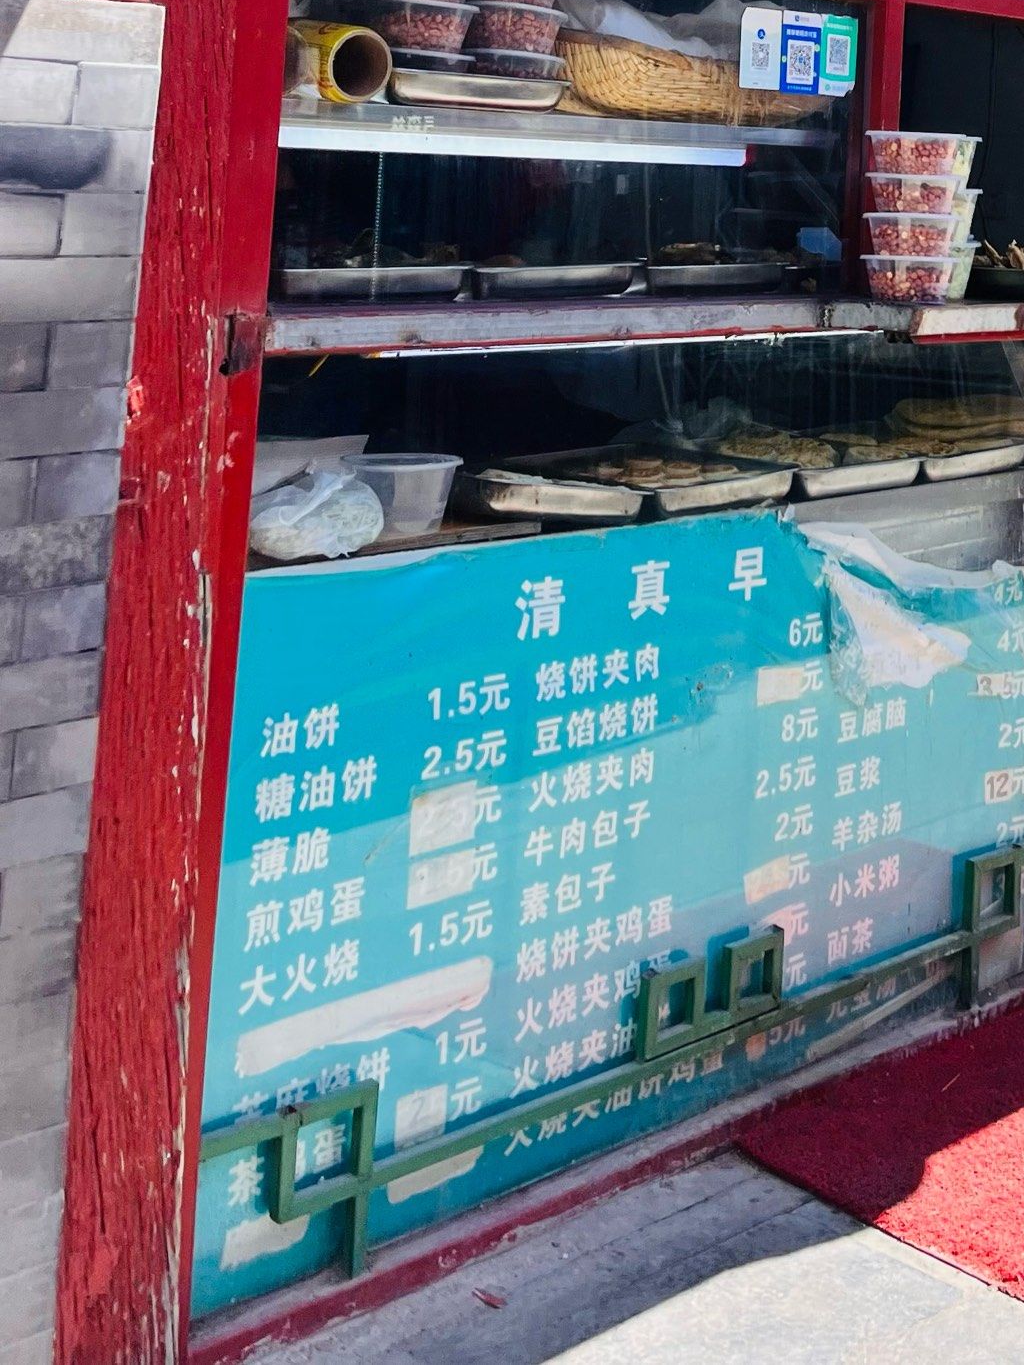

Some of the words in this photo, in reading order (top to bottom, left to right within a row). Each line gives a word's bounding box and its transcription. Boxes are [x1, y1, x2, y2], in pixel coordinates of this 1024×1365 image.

[534, 643, 660, 703] 烧饼夹肉
[788, 612, 824, 647] 6元
[260, 703, 340, 758] 油饼
[427, 673, 511, 720] 1.5元
[532, 694, 659, 757] 豆馅烧饼
[837, 697, 907, 743] 豆腐脑
[254, 755, 378, 823] 糖油饼
[420, 729, 507, 781] 2.5元
[528, 746, 655, 812] 火烧夹肉
[781, 707, 819, 743] 8元
[834, 756, 881, 798] 豆浆
[523, 799, 651, 866] 牛肉包子
[755, 755, 816, 799] 2.5元
[831, 801, 902, 852] 羊杂汤
[250, 827, 331, 886] 薄脆
[518, 861, 616, 926] 素包子
[774, 804, 814, 843] 2元
[829, 854, 900, 908] 小米粥
[244, 876, 366, 953] 煎鸡蛋
[516, 895, 673, 983] 烧饼夹鸡蛋
[238, 939, 360, 1015] 大火烧
[408, 900, 494, 956] 1.5元
[435, 1017, 488, 1065] 1元
